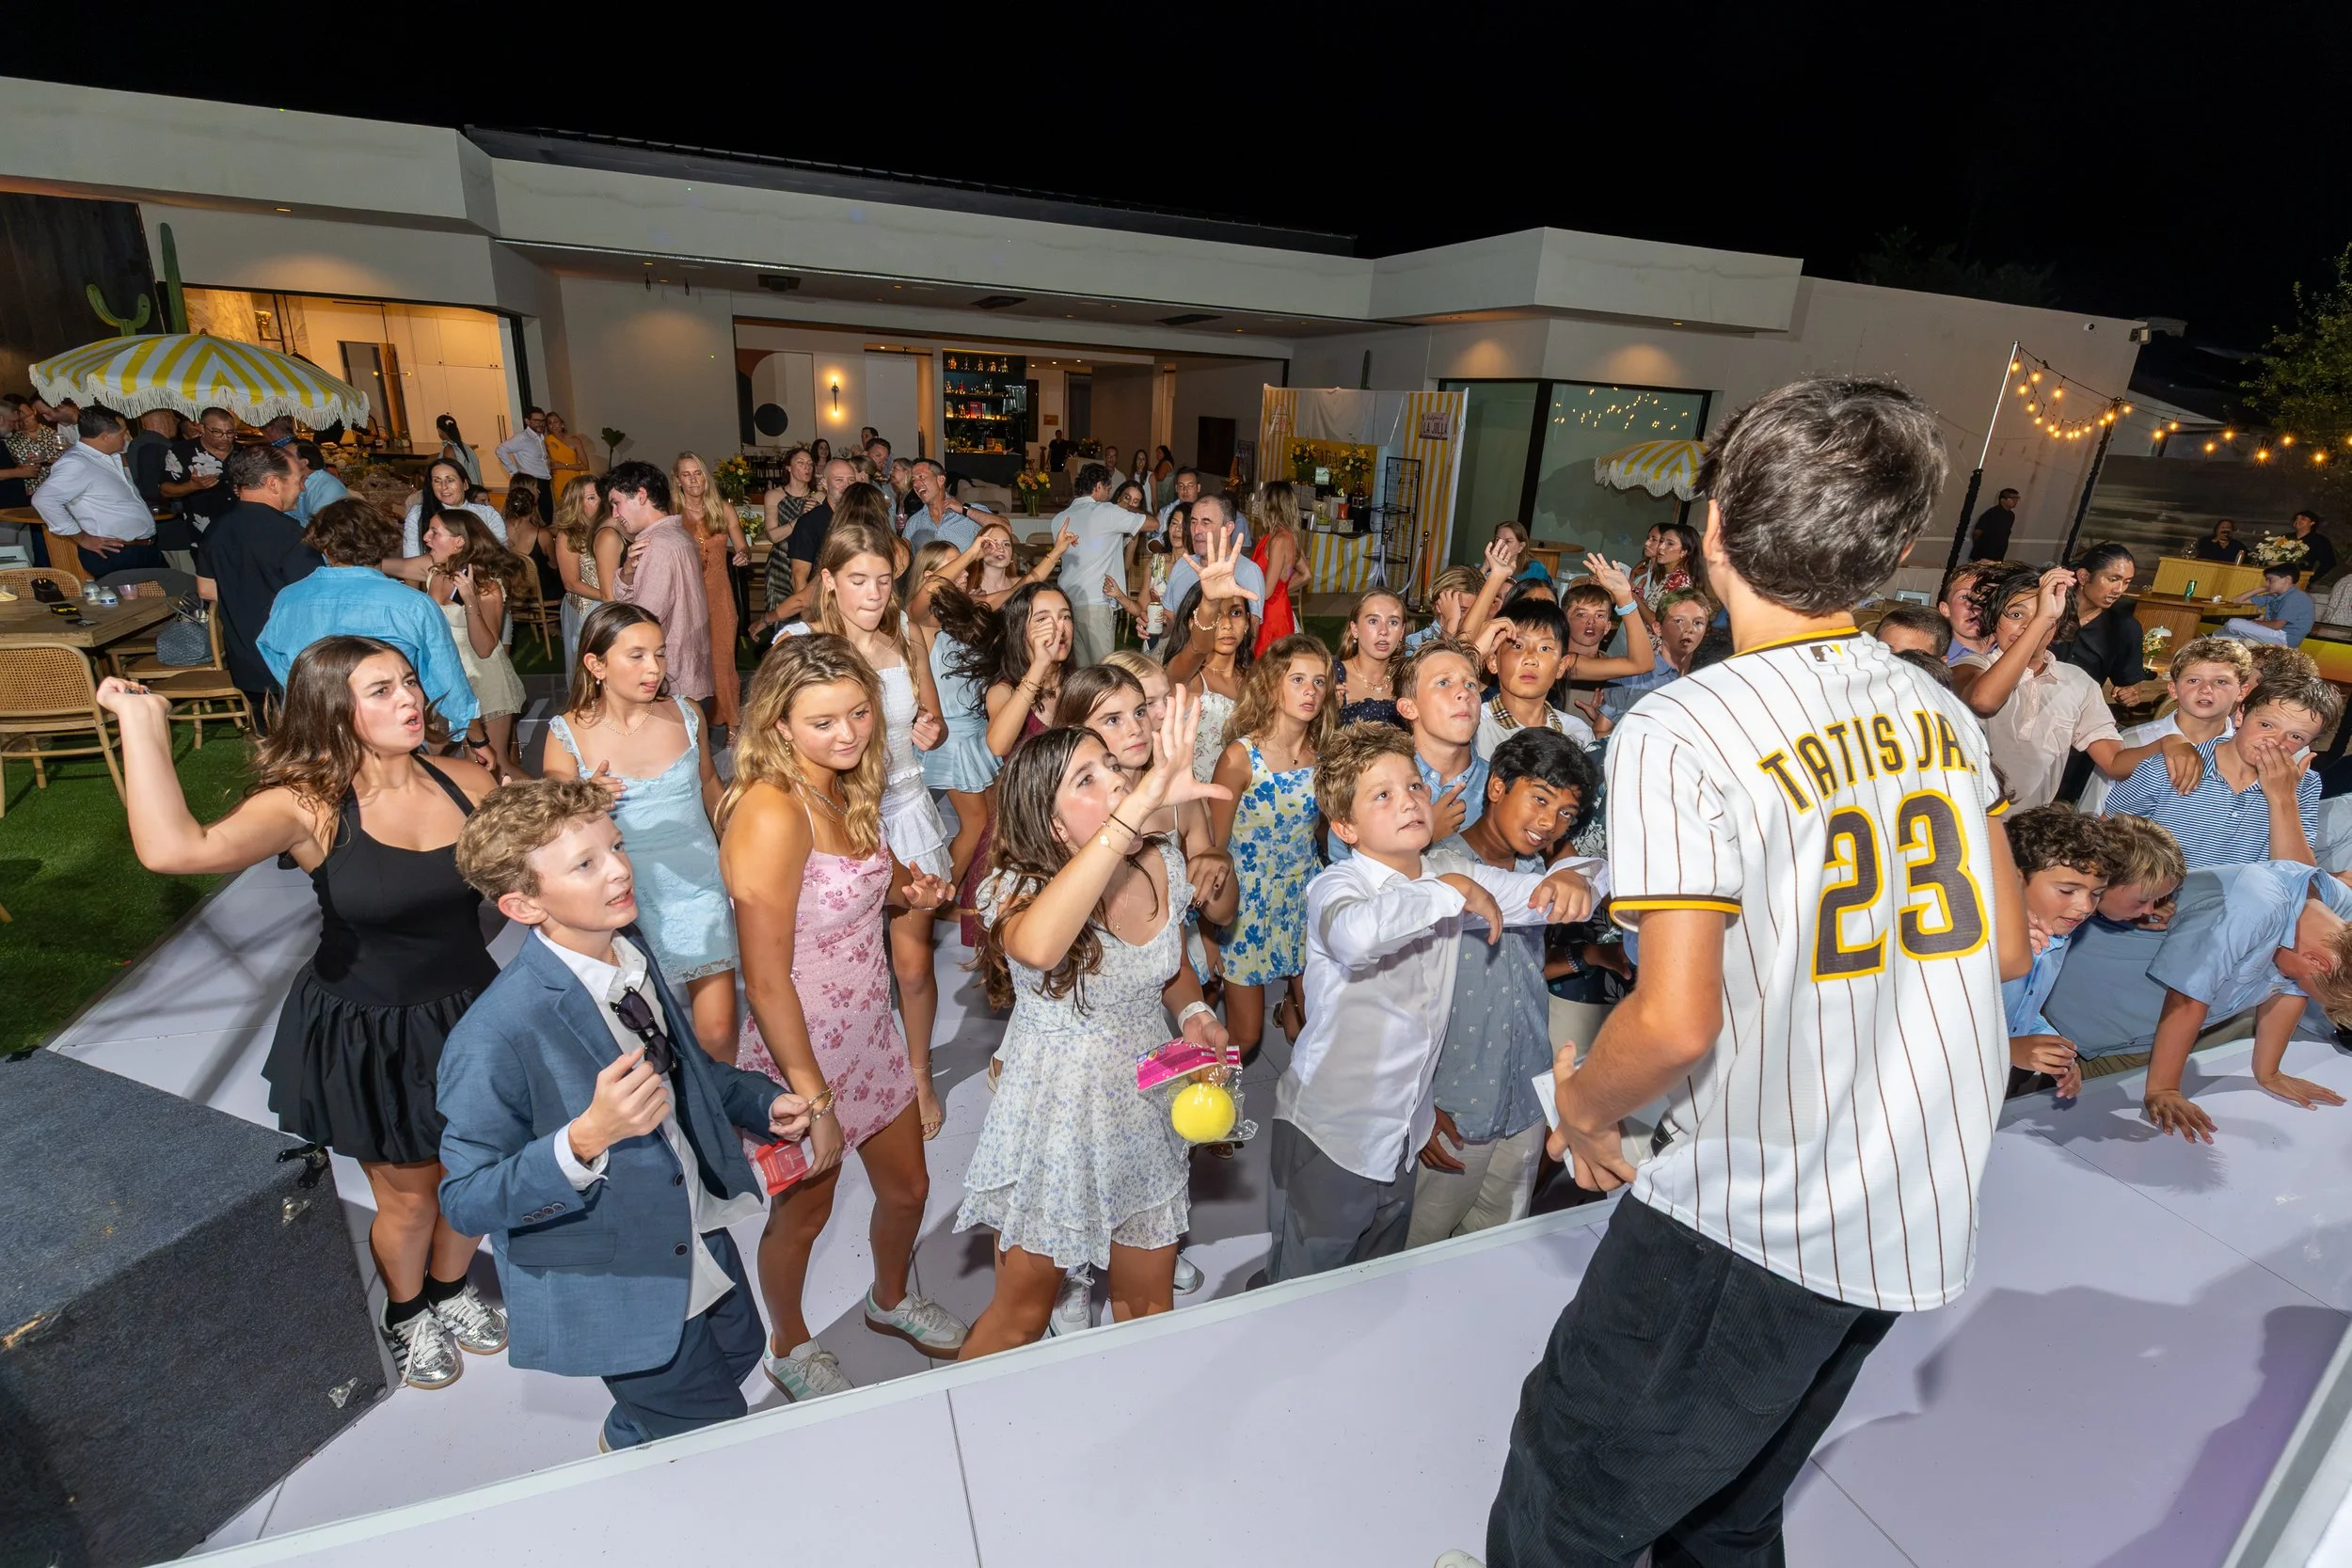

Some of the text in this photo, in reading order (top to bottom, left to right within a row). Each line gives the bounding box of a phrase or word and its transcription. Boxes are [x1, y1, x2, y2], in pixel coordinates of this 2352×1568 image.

[1757, 710, 1979, 814] TATIS JR.
[1811, 788, 1990, 983] 23
